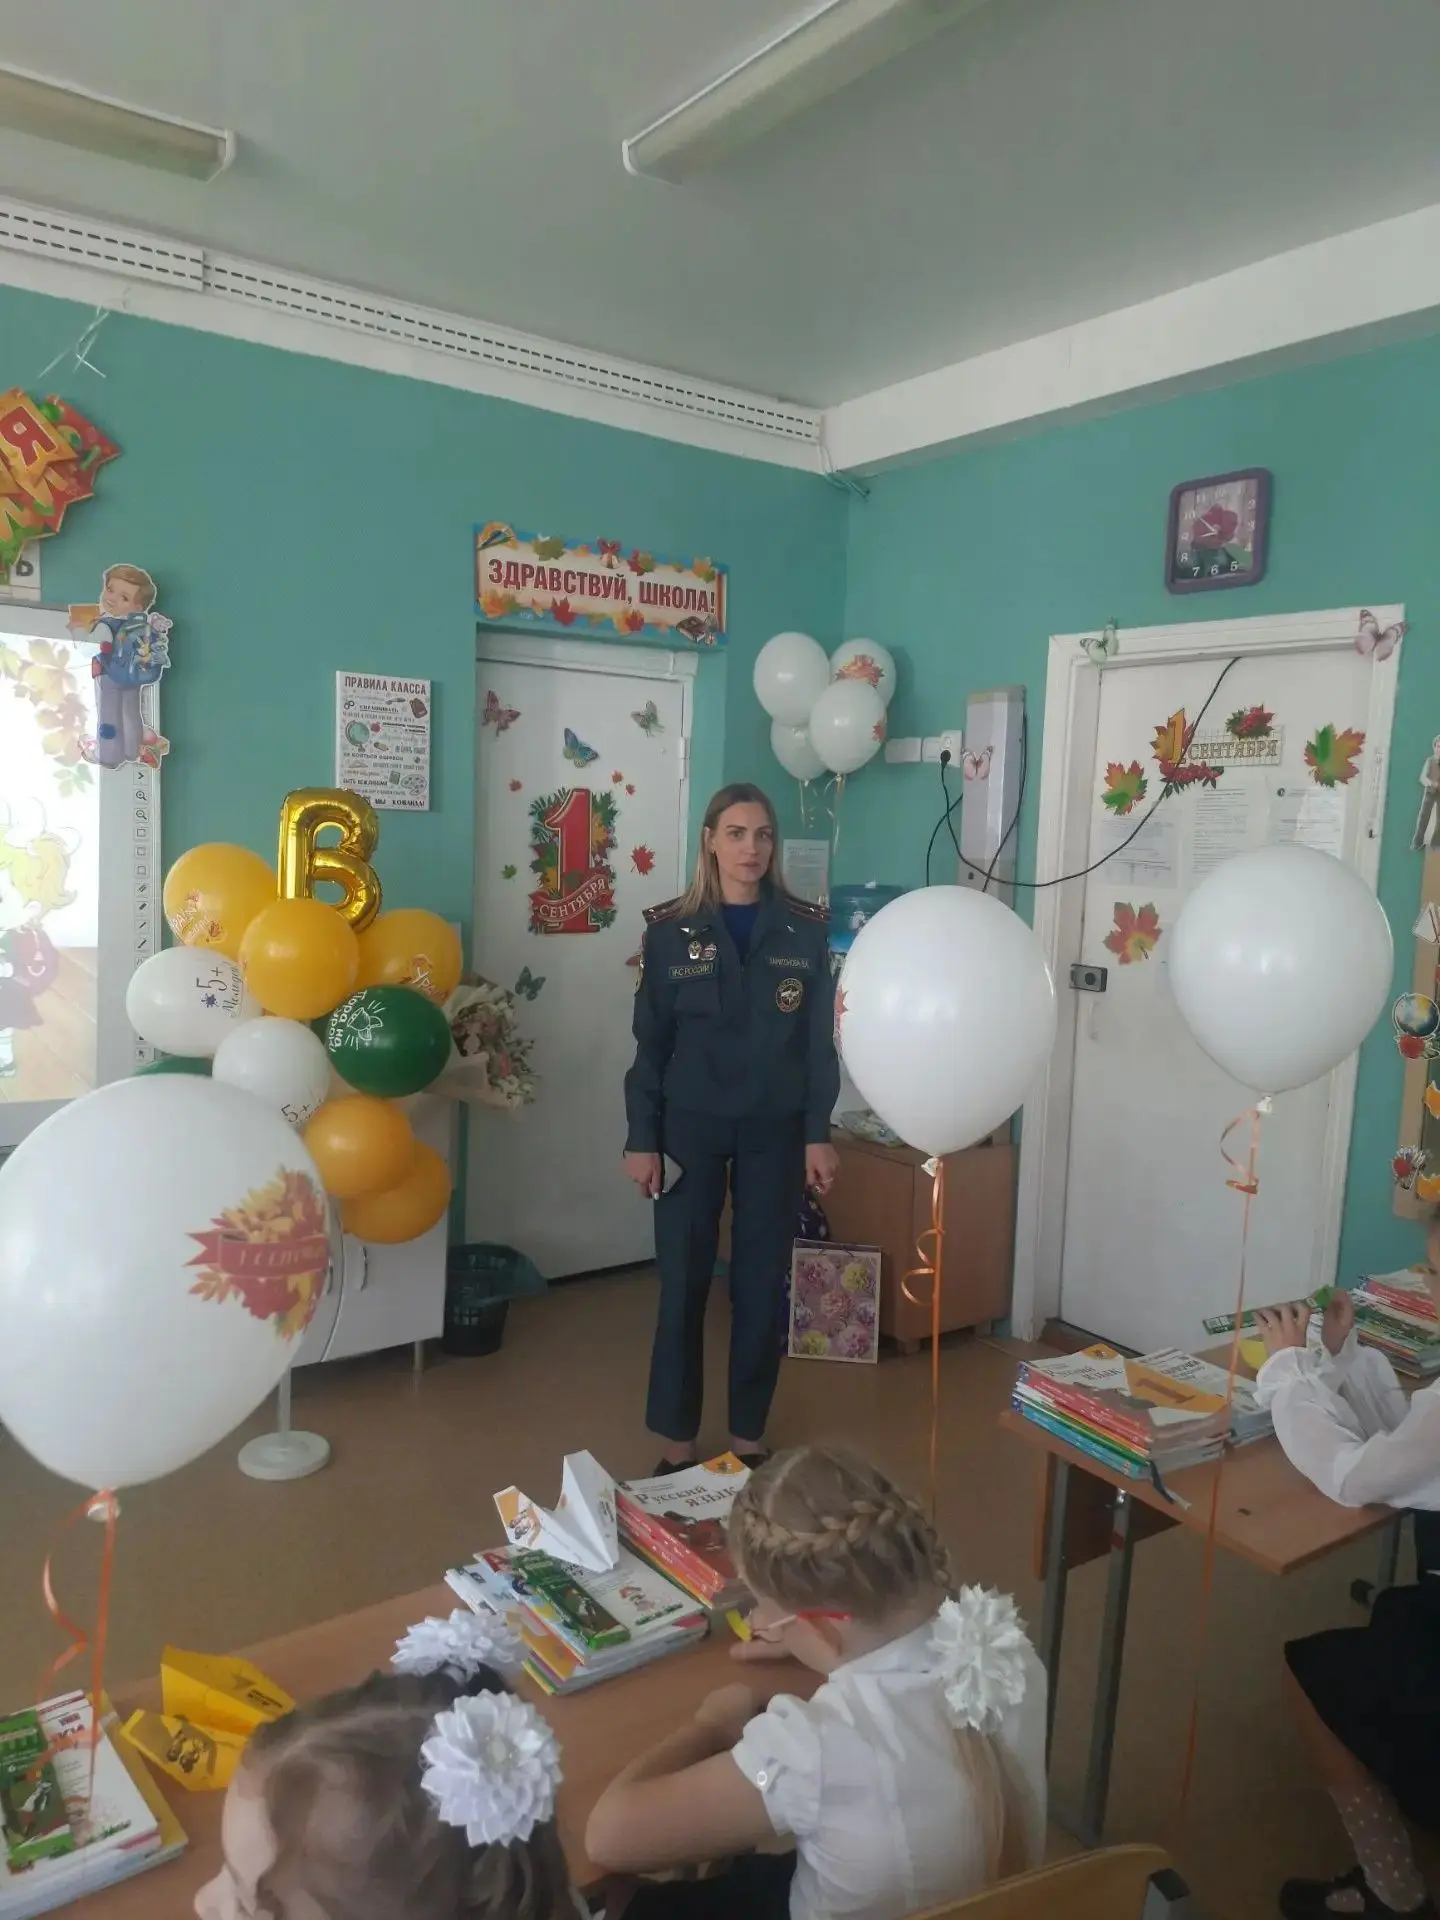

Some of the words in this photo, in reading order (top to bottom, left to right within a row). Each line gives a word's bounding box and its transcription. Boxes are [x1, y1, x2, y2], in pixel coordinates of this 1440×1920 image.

[1192, 566, 1199, 576] 7
[1210, 565, 1218, 575] 6
[488, 558, 632, 605] ЗДРАВСТВУЙ,
[639, 580, 716, 613] ШКОЛА!
[345, 676, 387, 691] ПРАВИЛА
[391, 683, 426, 695] КЛАССА
[1188, 740, 1279, 760] СЕНТЯБРЯ
[544, 788, 601, 934] 1
[539, 878, 606, 919] СЕНТЯБРЯ
[195, 966, 228, 992] 5+
[339, 990, 368, 1023] Пора
[334, 1028, 344, 1047] на
